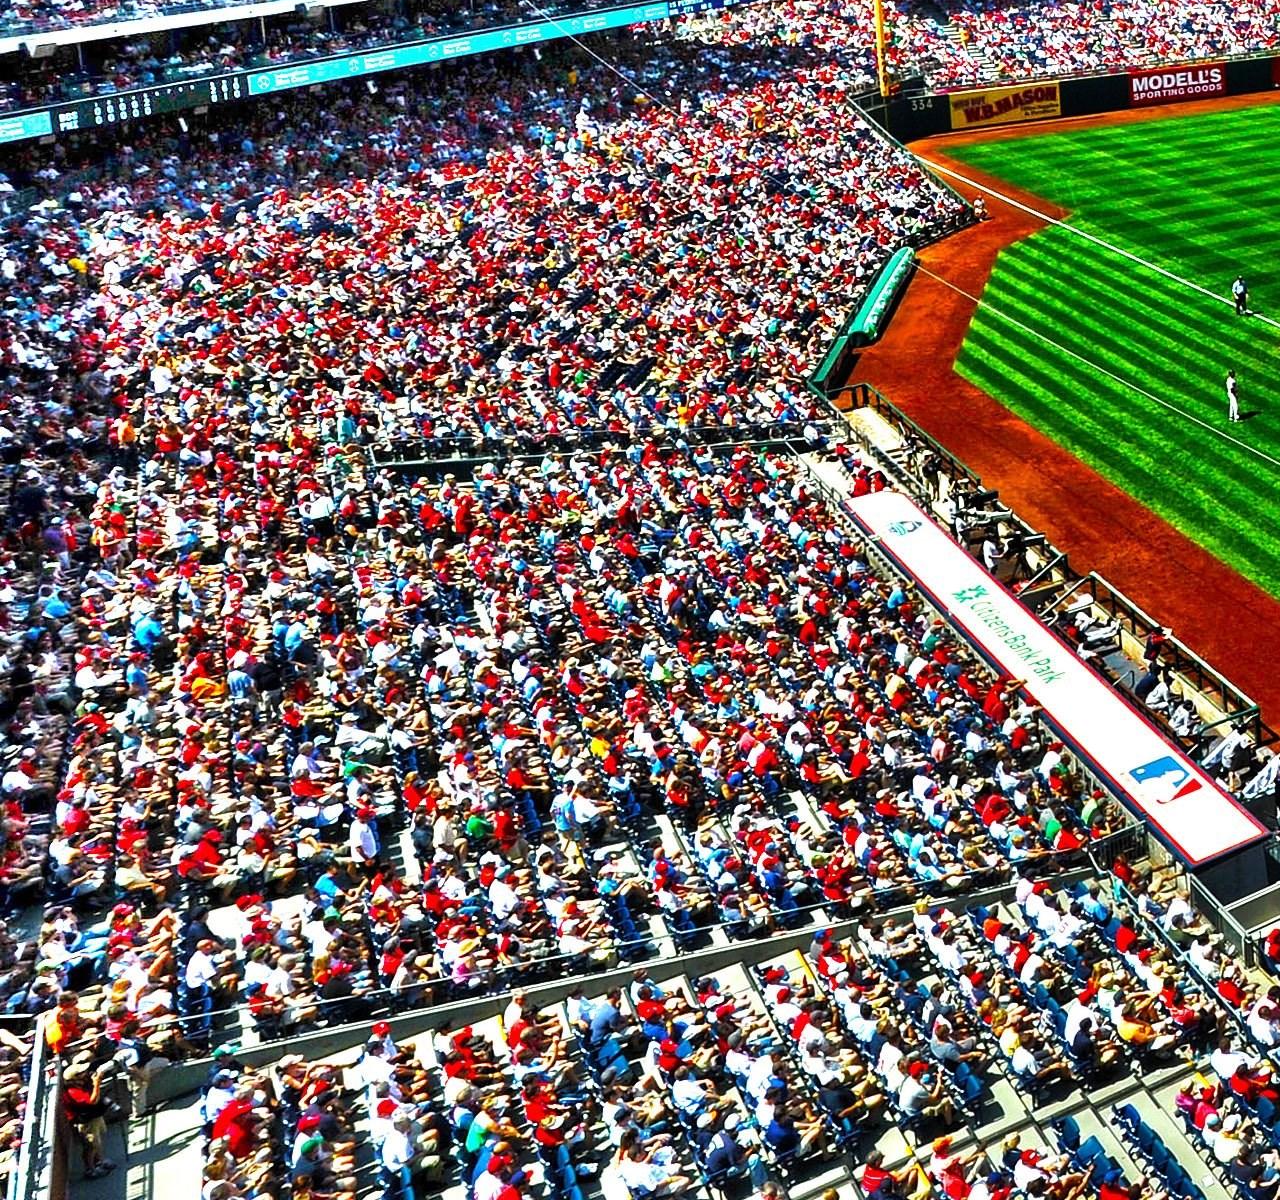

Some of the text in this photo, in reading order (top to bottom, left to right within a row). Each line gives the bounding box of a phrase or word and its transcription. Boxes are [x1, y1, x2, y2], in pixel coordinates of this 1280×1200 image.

[1132, 68, 1222, 93] MODELL'S
[1133, 83, 1223, 101] SPORTING GOODS
[911, 98, 933, 112] 334
[970, 601, 1066, 684] Citizens Bank Park
